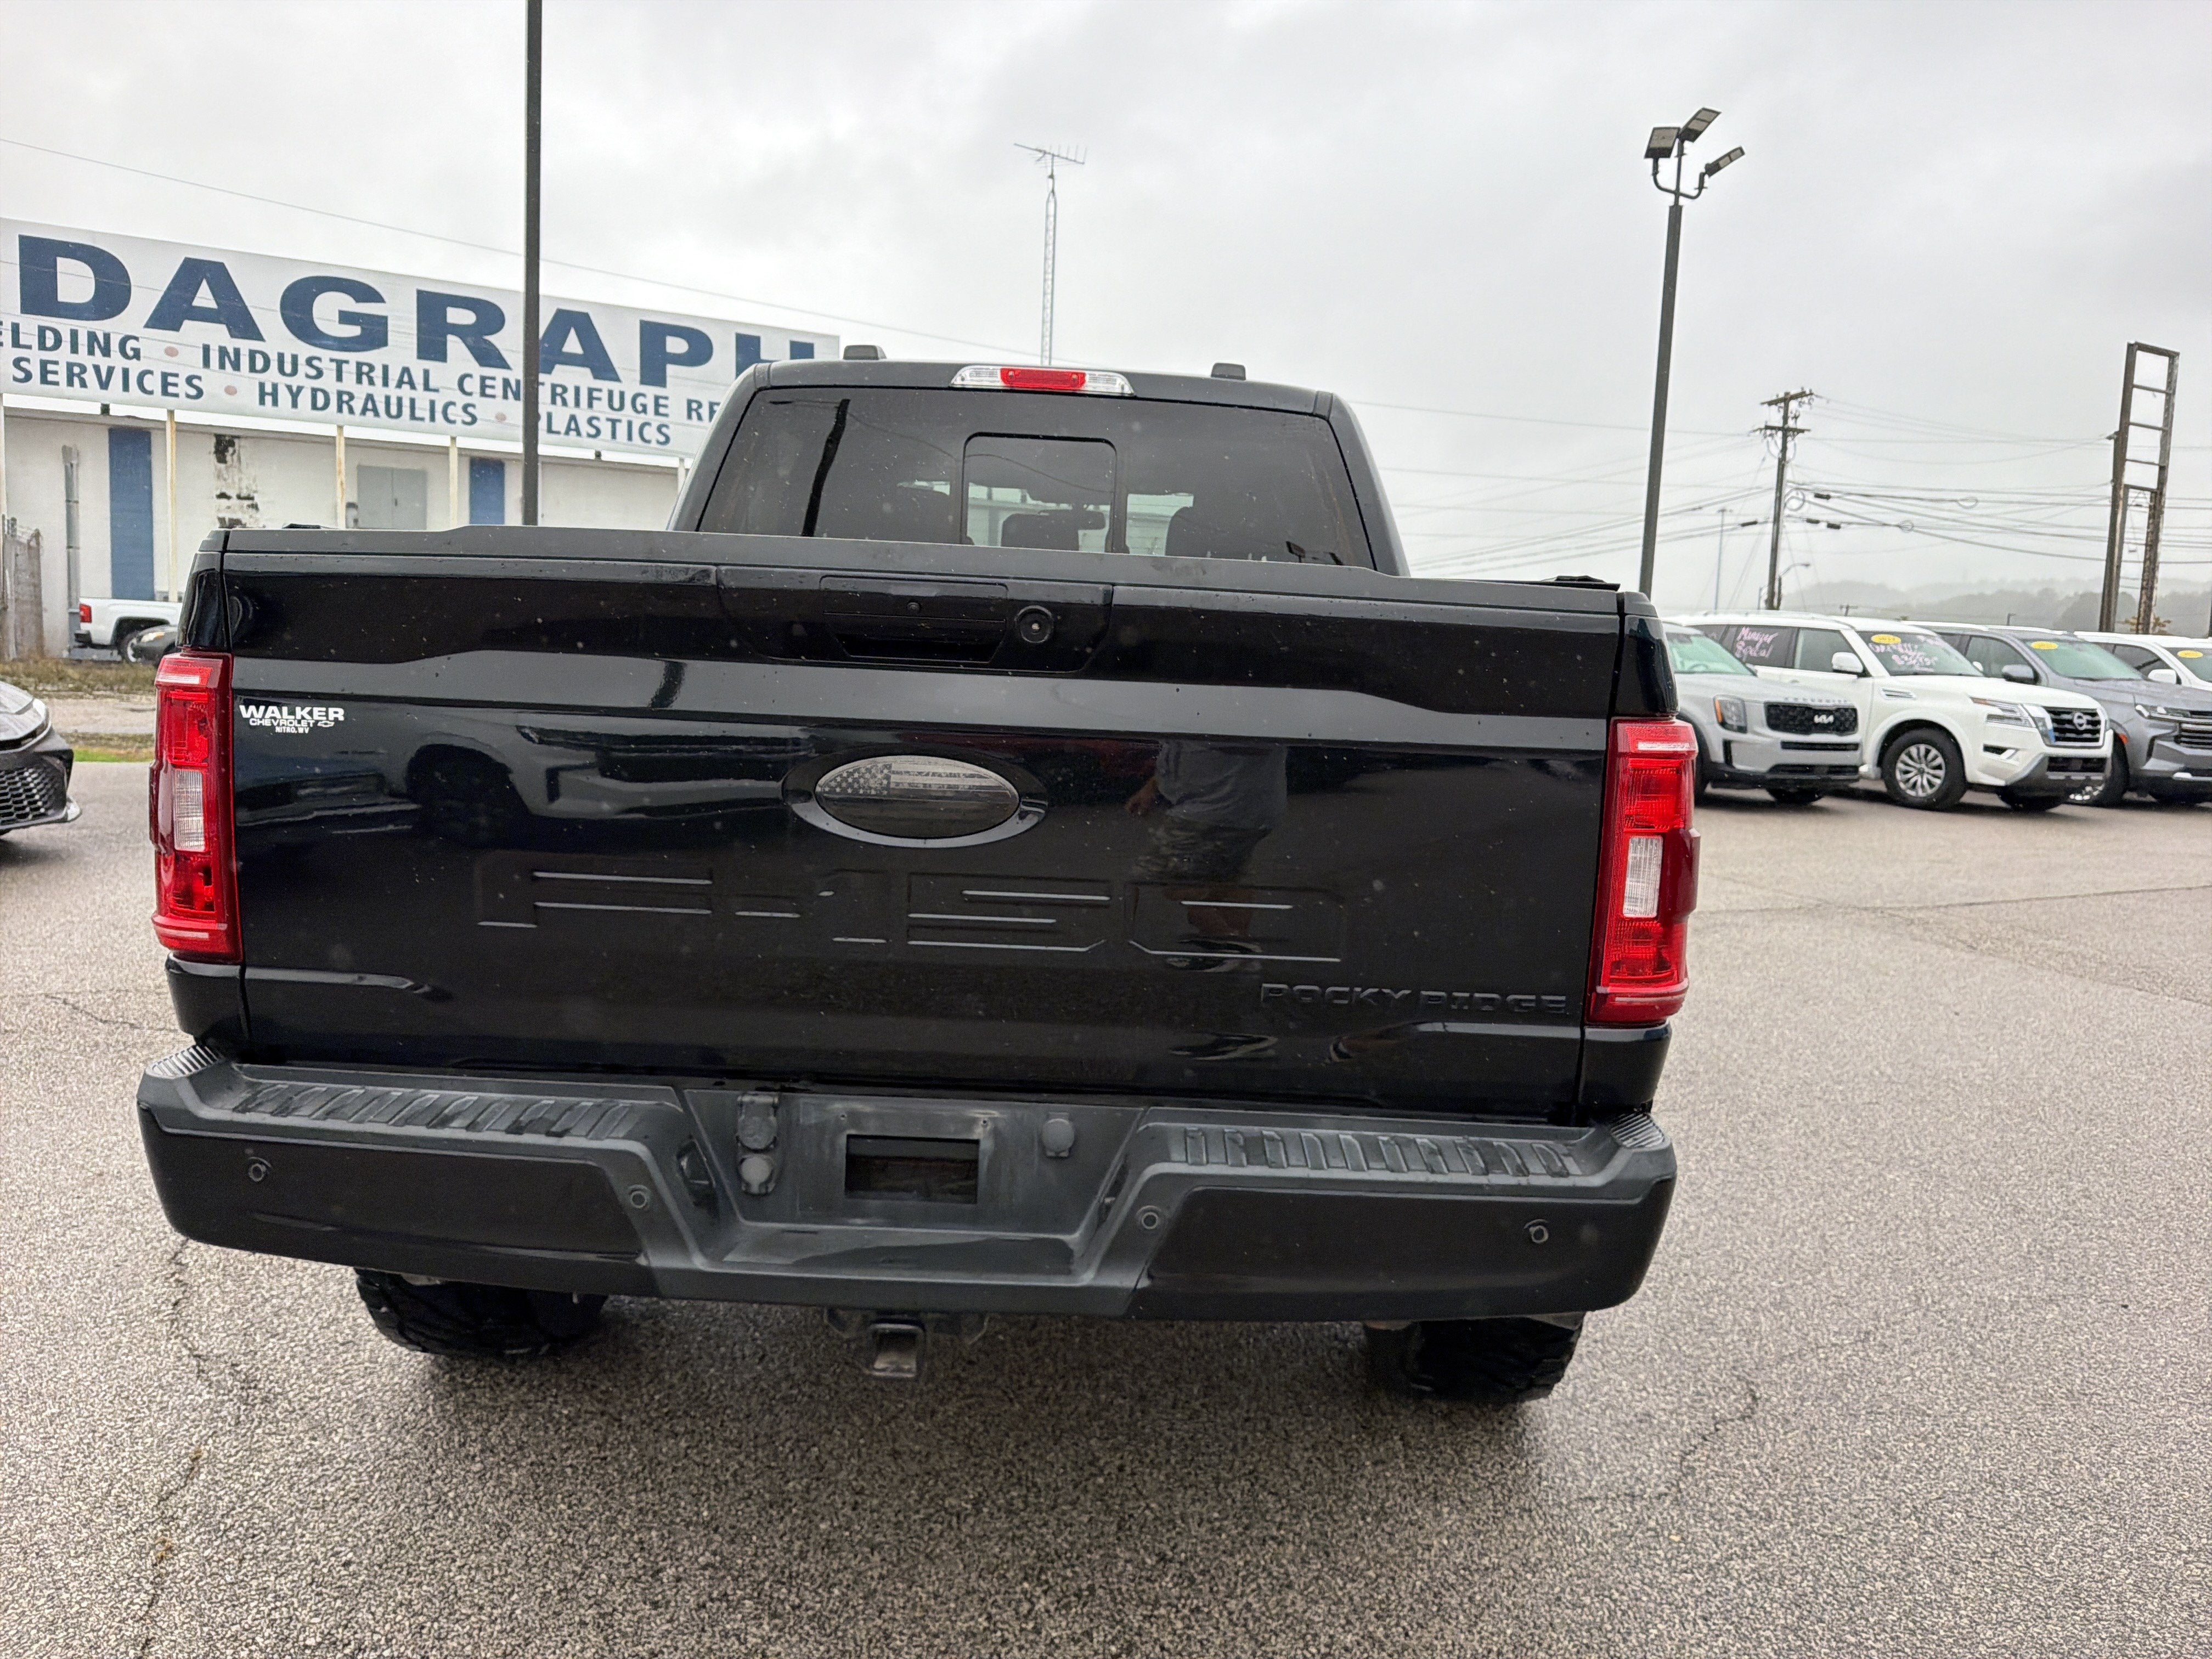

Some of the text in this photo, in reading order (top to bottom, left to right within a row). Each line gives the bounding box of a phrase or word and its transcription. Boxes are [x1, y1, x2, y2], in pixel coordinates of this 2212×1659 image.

[0, 321, 141, 361] LDING
[202, 343, 439, 393] INDUSTRIAL
[457, 373, 669, 417] CENRIFUGE
[12, 356, 670, 445] SERVICES HYDRAULICS LASTICS
[239, 705, 345, 721] WALKER
[249, 718, 315, 727] CHEVROLET
